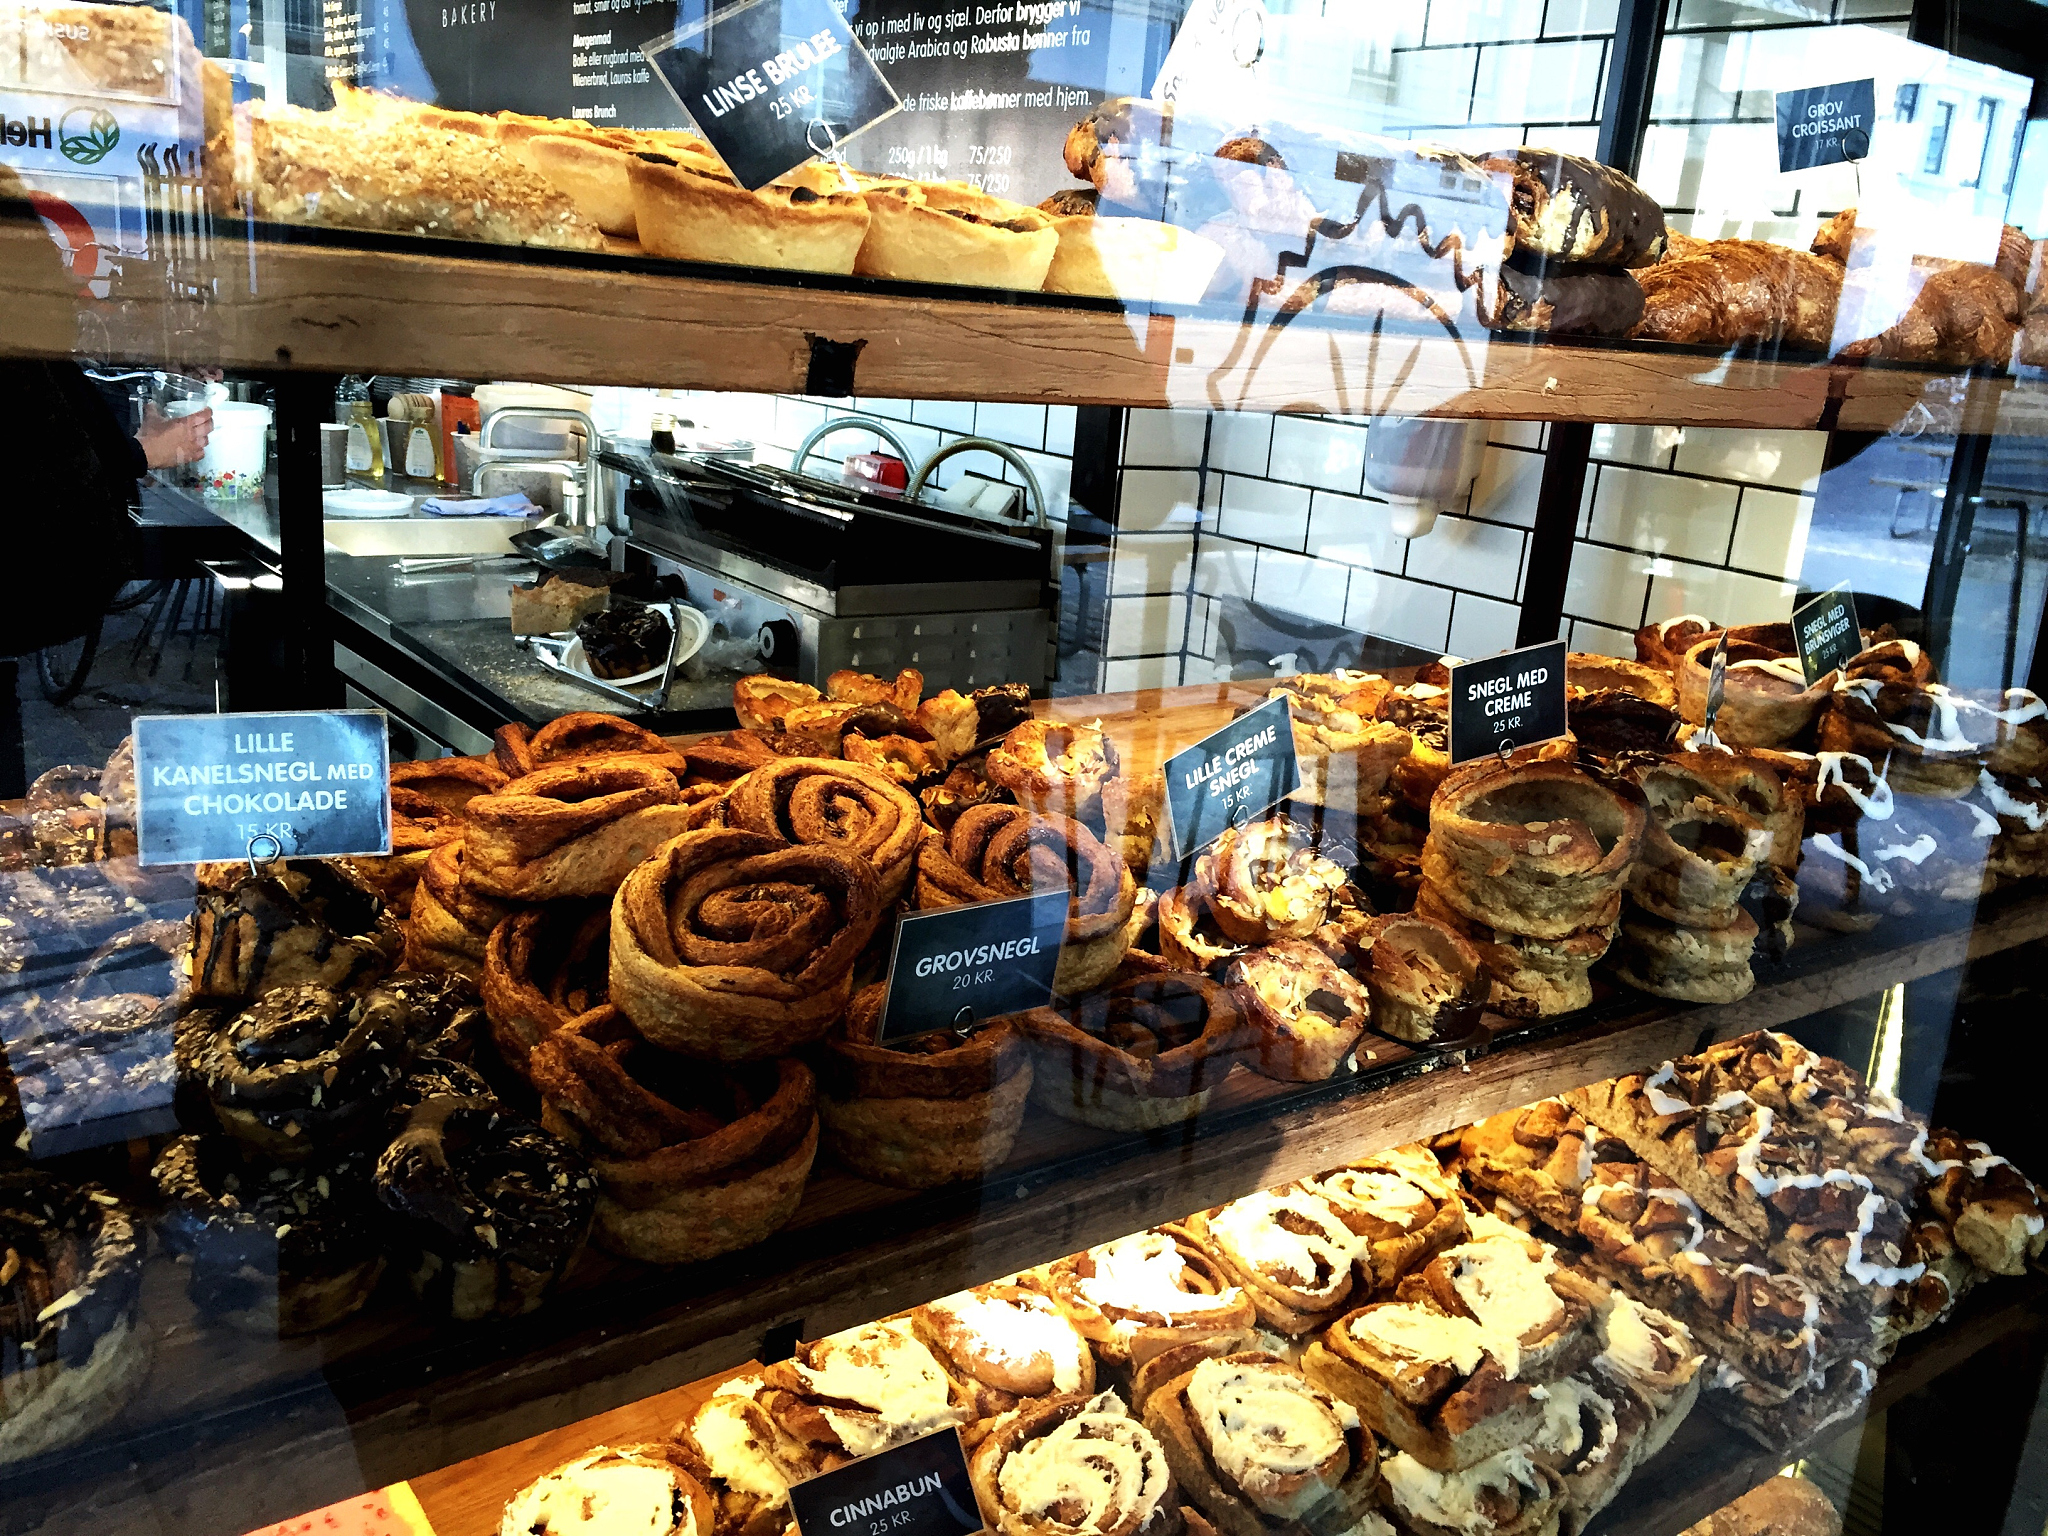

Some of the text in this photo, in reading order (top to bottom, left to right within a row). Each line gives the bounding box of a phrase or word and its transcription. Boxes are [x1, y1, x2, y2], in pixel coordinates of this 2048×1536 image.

[442, 1, 496, 28] BAKERY
[855, 0, 1081, 40] vi op i med liv og sjæl. Derfor brygger vi
[907, 37, 950, 60] Arabica
[952, 42, 968, 61] og
[971, 31, 1020, 55] Robusta
[1022, 28, 1069, 51] bønner
[1071, 24, 1091, 47] fra
[702, 68, 769, 118] LINSE
[769, 84, 819, 120] 25 KR.
[902, 85, 1093, 112] de friske kaffebønner med hjem.
[593, 103, 617, 119] Brunch
[1807, 100, 1844, 119] GROV
[1791, 114, 1862, 139] CROISSANT
[888, 146, 916, 170] 250g
[968, 145, 1012, 166] 75/250
[1814, 139, 1824, 150] 17
[1803, 603, 1845, 640] SNEGL MED
[1804, 616, 1851, 656] BRUNSVIGER
[1467, 667, 1548, 702] SNEGL MED
[1484, 690, 1532, 717] CREME
[1493, 715, 1524, 734] 25 KR.
[234, 732, 295, 754] LILLE
[1185, 724, 1277, 790] LILLE CREME
[152, 761, 374, 787] KANELSNEGL MED
[1209, 758, 1260, 798] SNEGL
[183, 789, 348, 816] CHOKOLADE
[1221, 785, 1253, 810] 15 KR.
[237, 821, 298, 840] 15 KR.
[915, 935, 1040, 978] GROVSNEGL
[952, 968, 996, 990] 20 KR.
[829, 1471, 943, 1528] CINNABUN
[869, 1509, 916, 1536] 25 KR.
